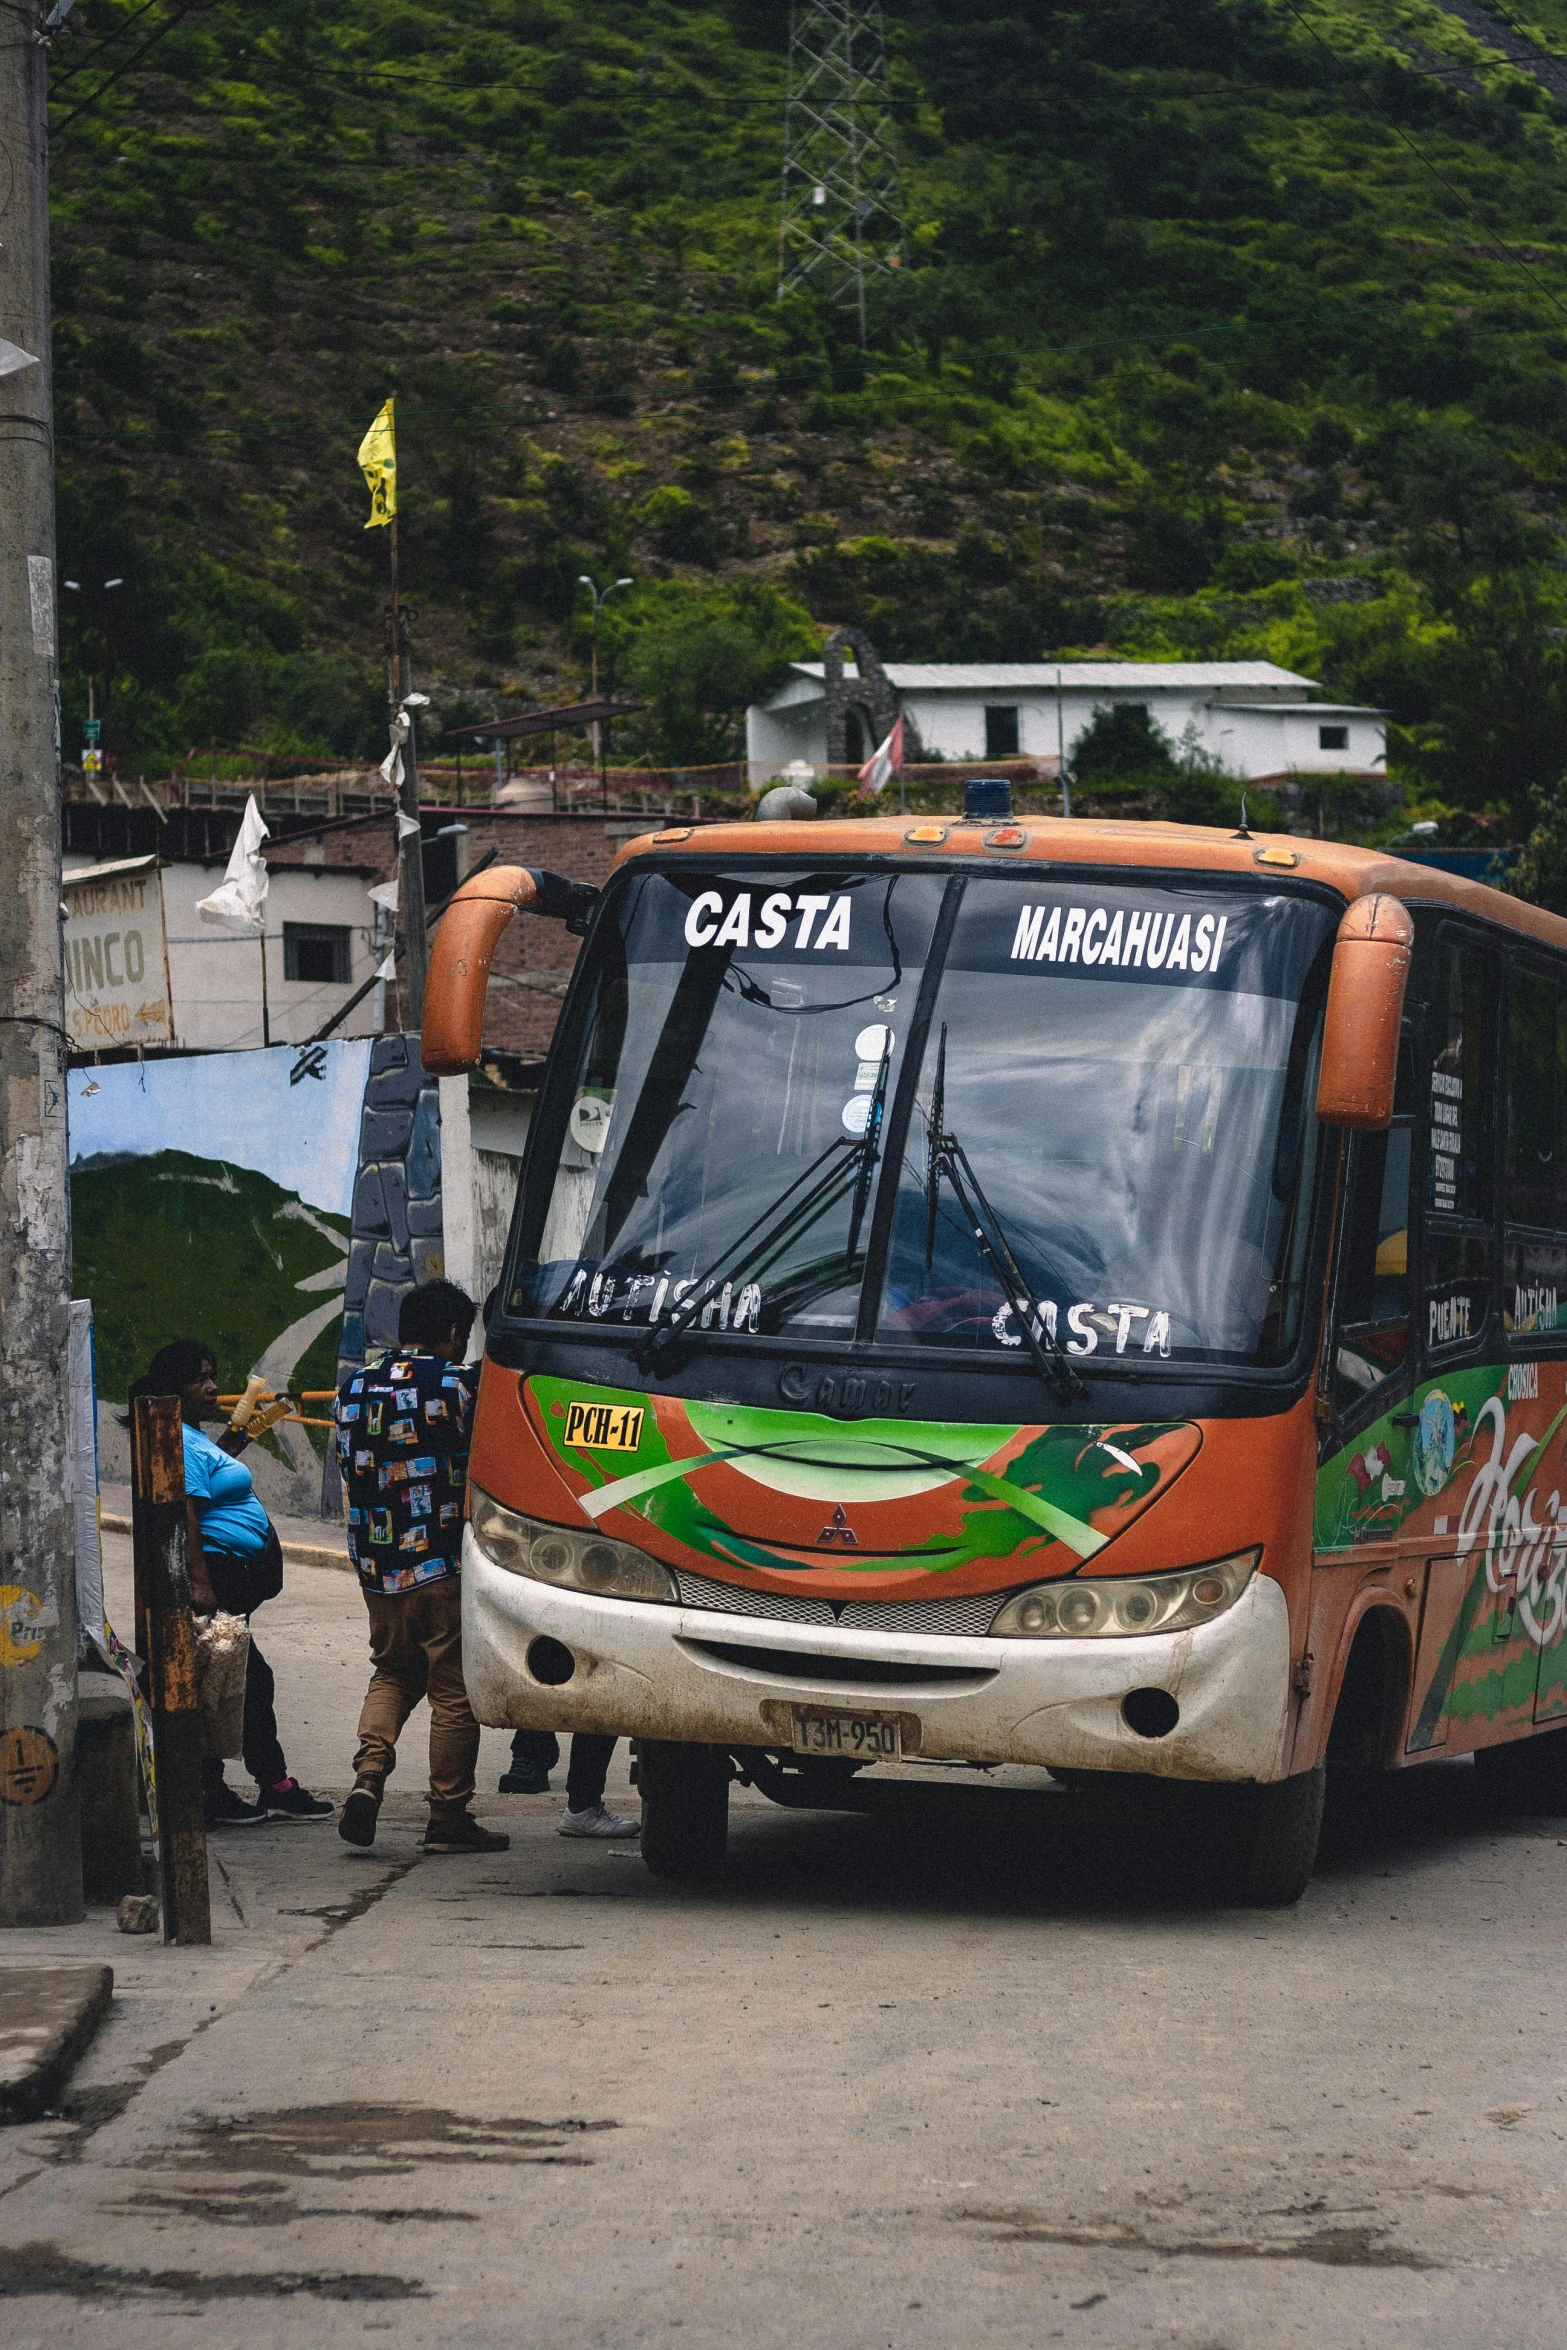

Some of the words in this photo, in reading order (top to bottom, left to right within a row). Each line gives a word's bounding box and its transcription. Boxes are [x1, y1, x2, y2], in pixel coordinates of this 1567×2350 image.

[684, 890, 852, 951] CASTA
[1010, 904, 1228, 973] MARCAHUASI
[991, 1300, 1172, 1357] CASTA
[1429, 1296, 1471, 1346] PUENTE
[1507, 1362, 1538, 1401] CHOSICA
[565, 1405, 642, 1448] PCH-11
[796, 1715, 896, 1754] T3M-950
